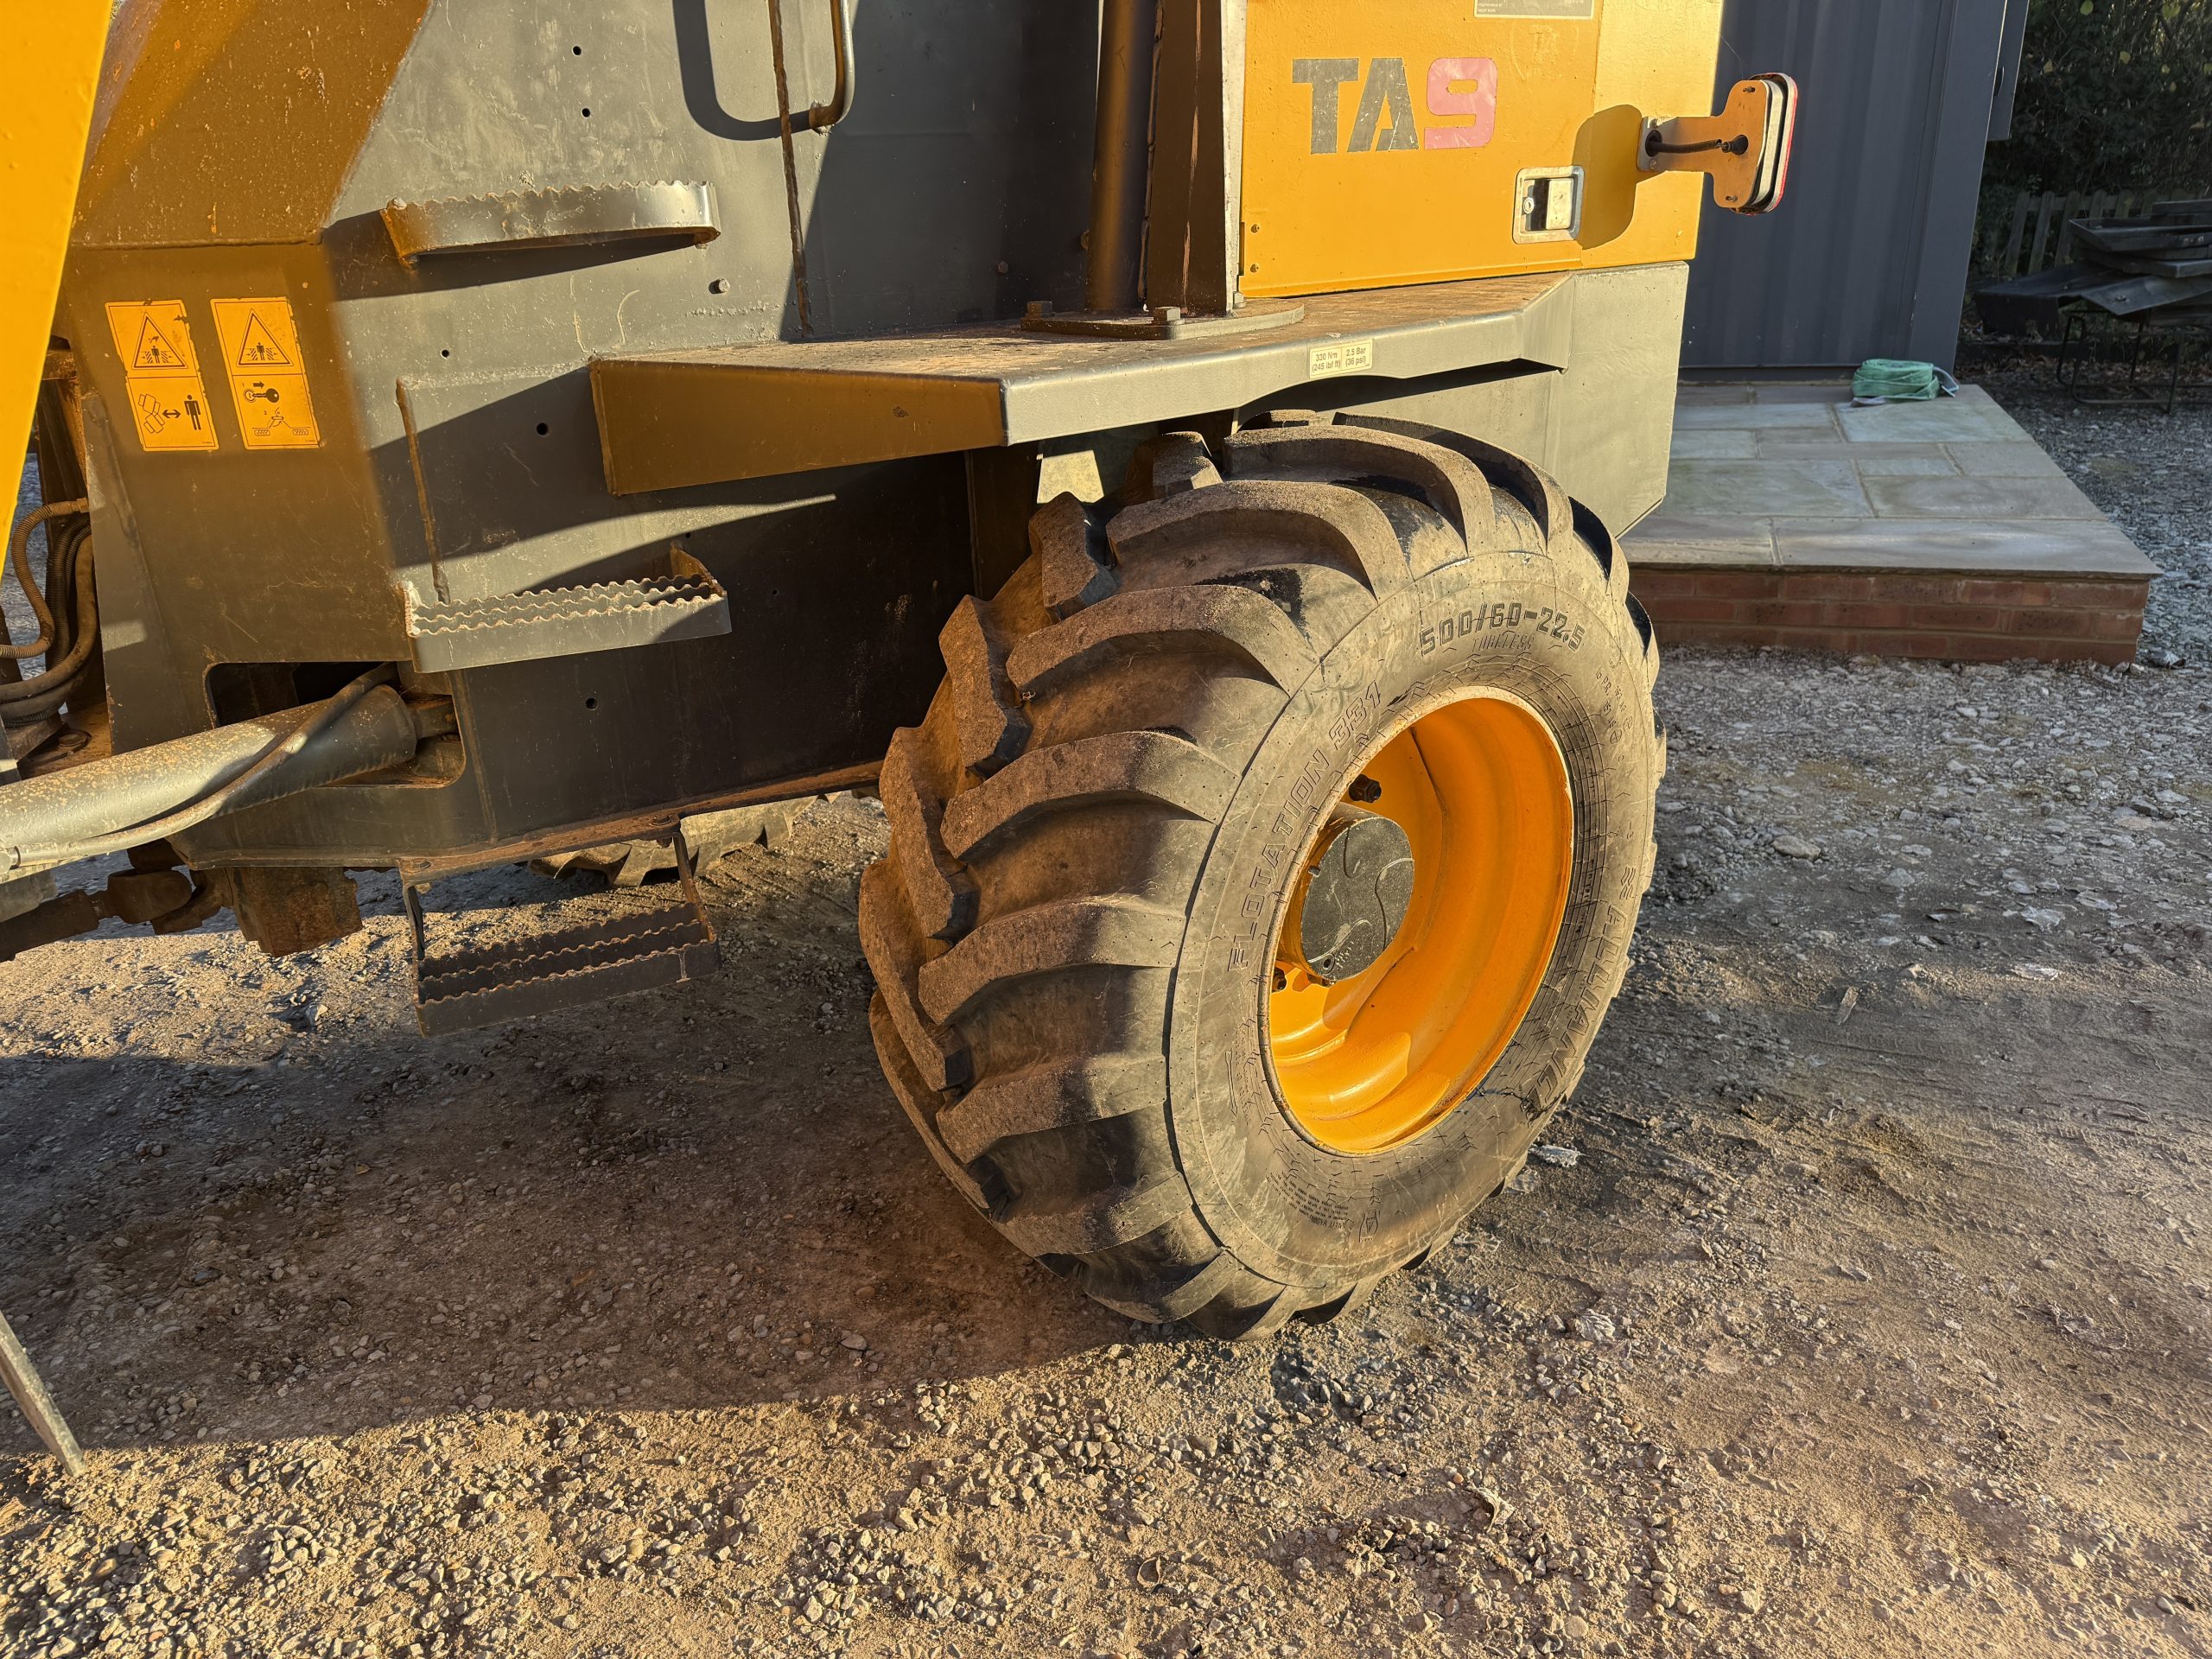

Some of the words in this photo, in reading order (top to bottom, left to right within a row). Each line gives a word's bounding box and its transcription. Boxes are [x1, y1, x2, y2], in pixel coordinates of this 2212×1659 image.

[1292, 57, 1498, 155] TA9
[1315, 353, 1326, 362] 330
[1345, 358, 1355, 367] (36
[1356, 355, 1366, 365] psi)
[1346, 348, 1355, 357] 2.5
[1420, 602, 1586, 657] 500/60-22.5
[1228, 748, 1330, 972] FLOTATION
[1328, 679, 1382, 751] 331
[1520, 905, 1628, 1128] ALLIANCE
